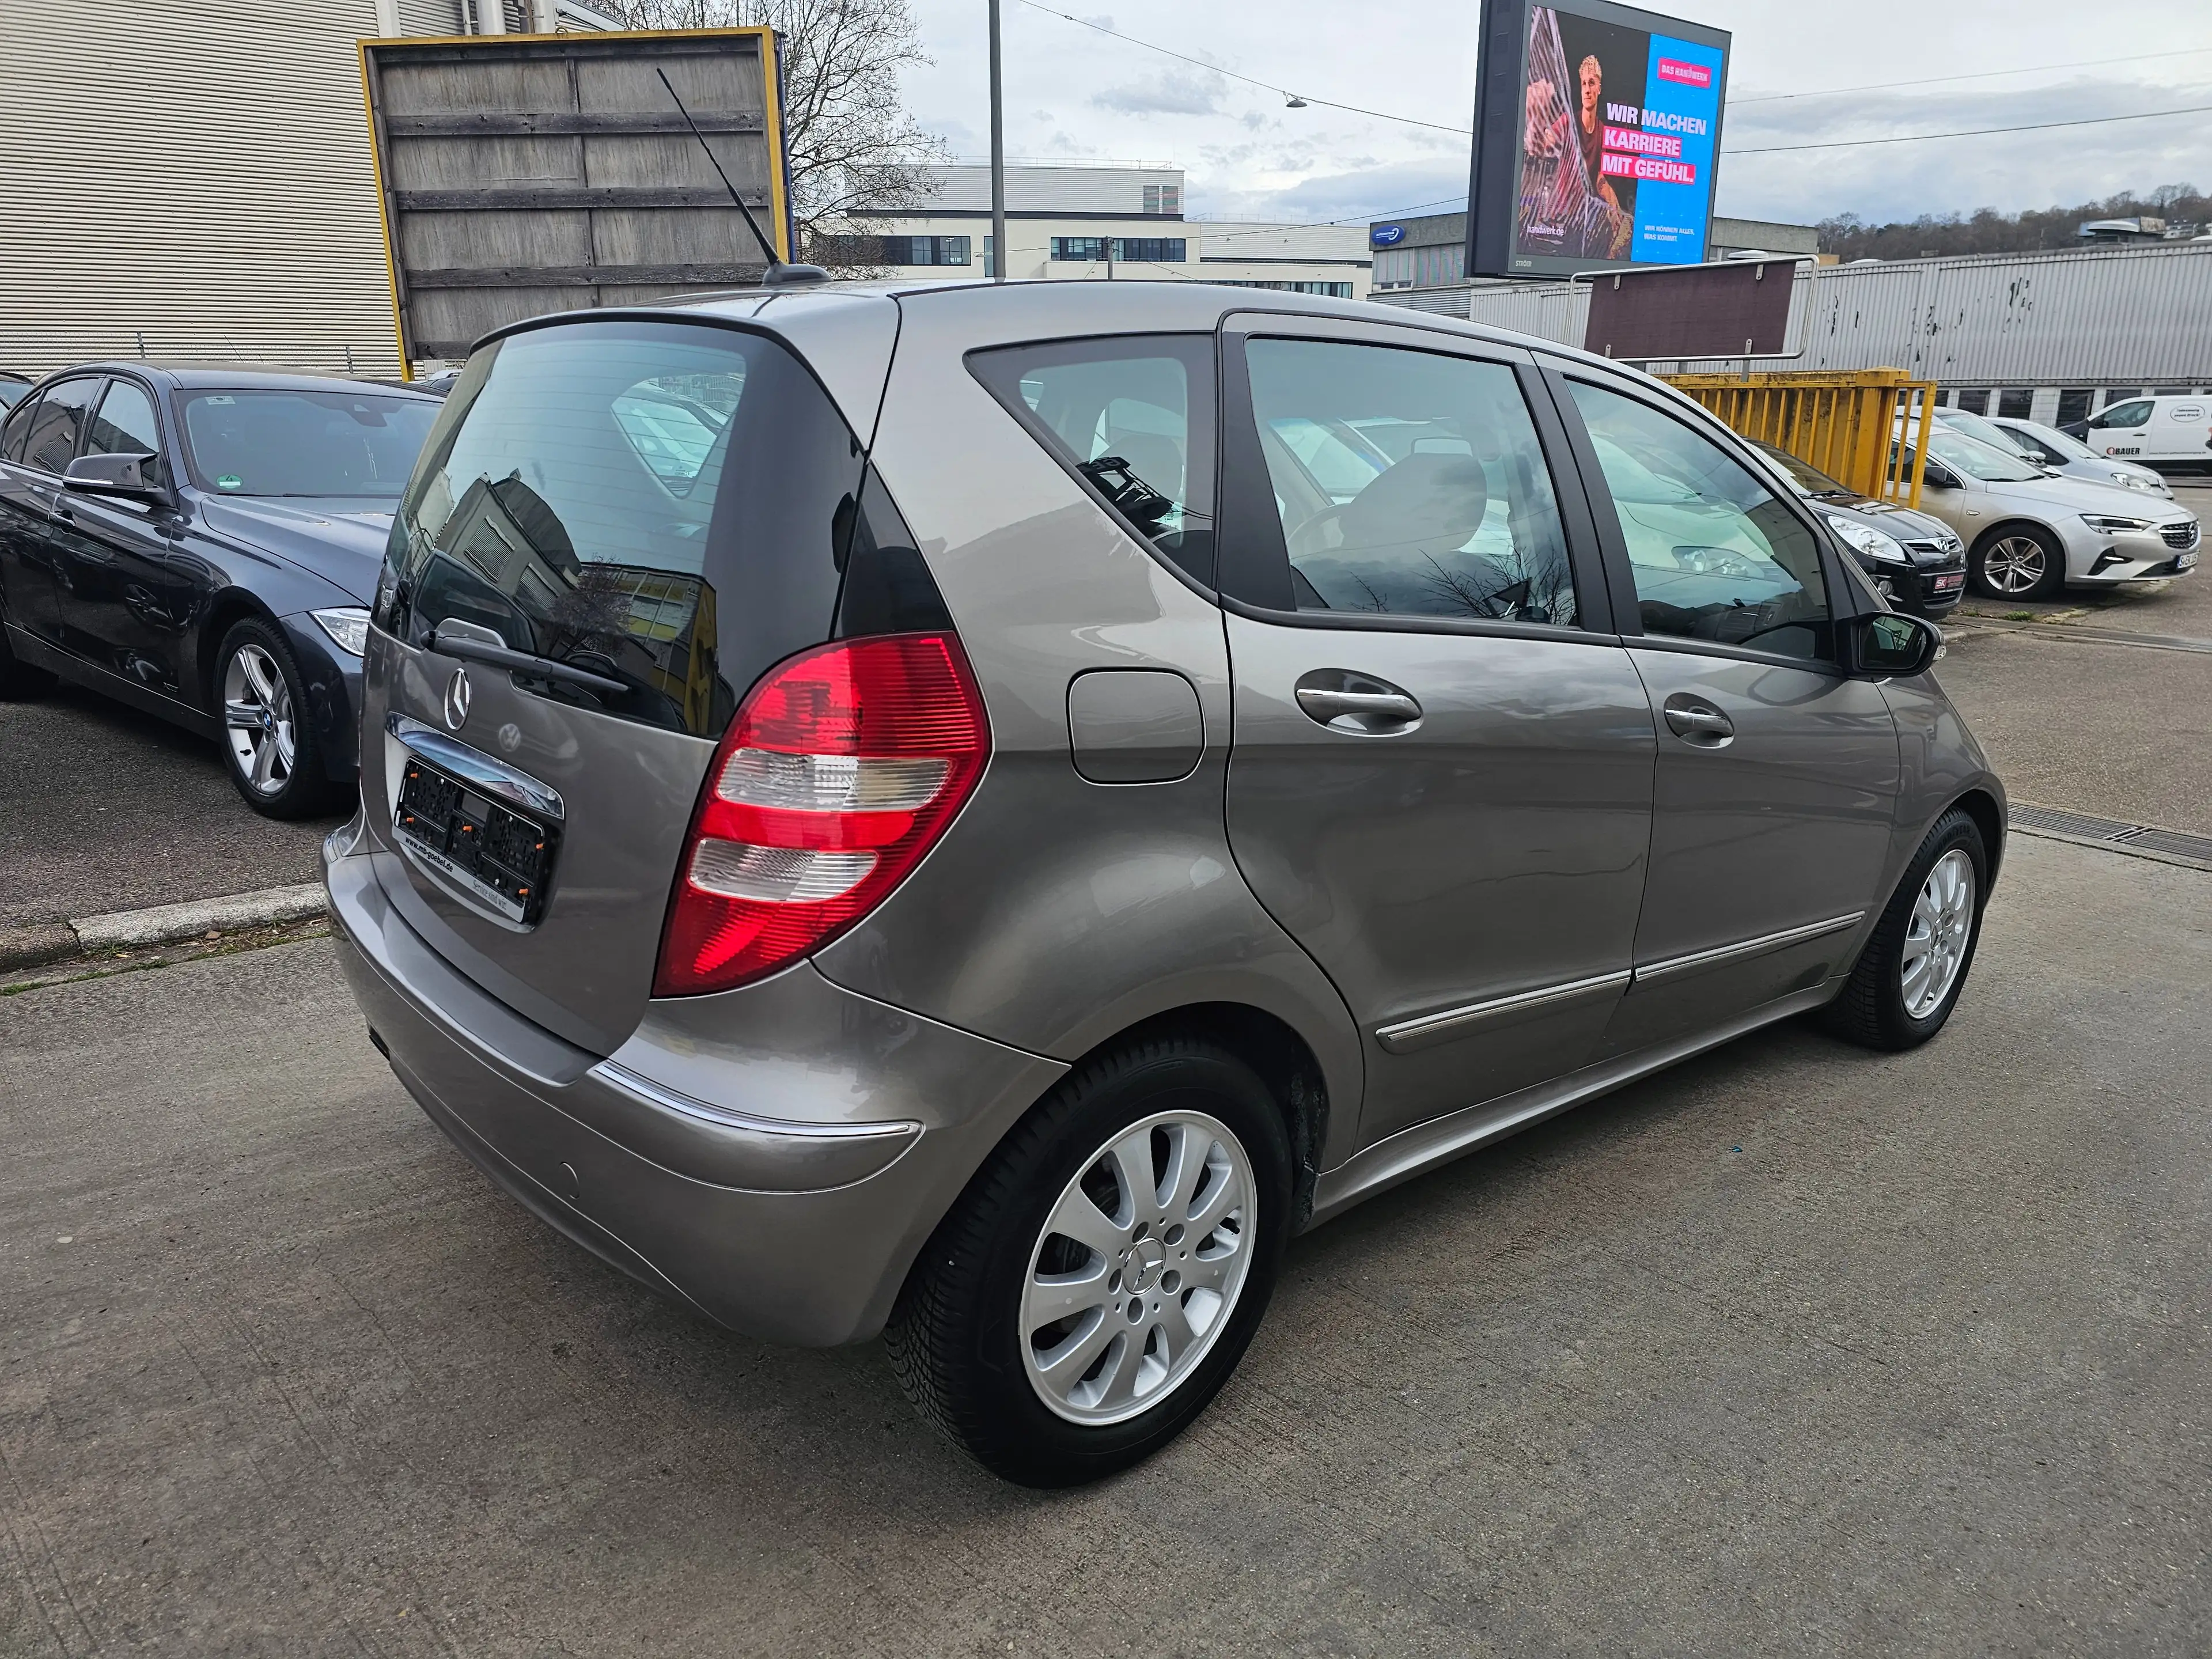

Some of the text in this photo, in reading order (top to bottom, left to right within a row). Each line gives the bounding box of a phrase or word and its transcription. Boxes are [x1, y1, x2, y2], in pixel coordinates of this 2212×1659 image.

[1661, 65, 1674, 74] DAS
[1607, 103, 1707, 135] WIR MACHEN
[1604, 129, 1681, 156] KARRIERE
[1602, 155, 1694, 183] MIT GEFÜHL.
[1527, 224, 1565, 237] handwerk.de
[405, 836, 453, 872] www.mb-goebel.de
